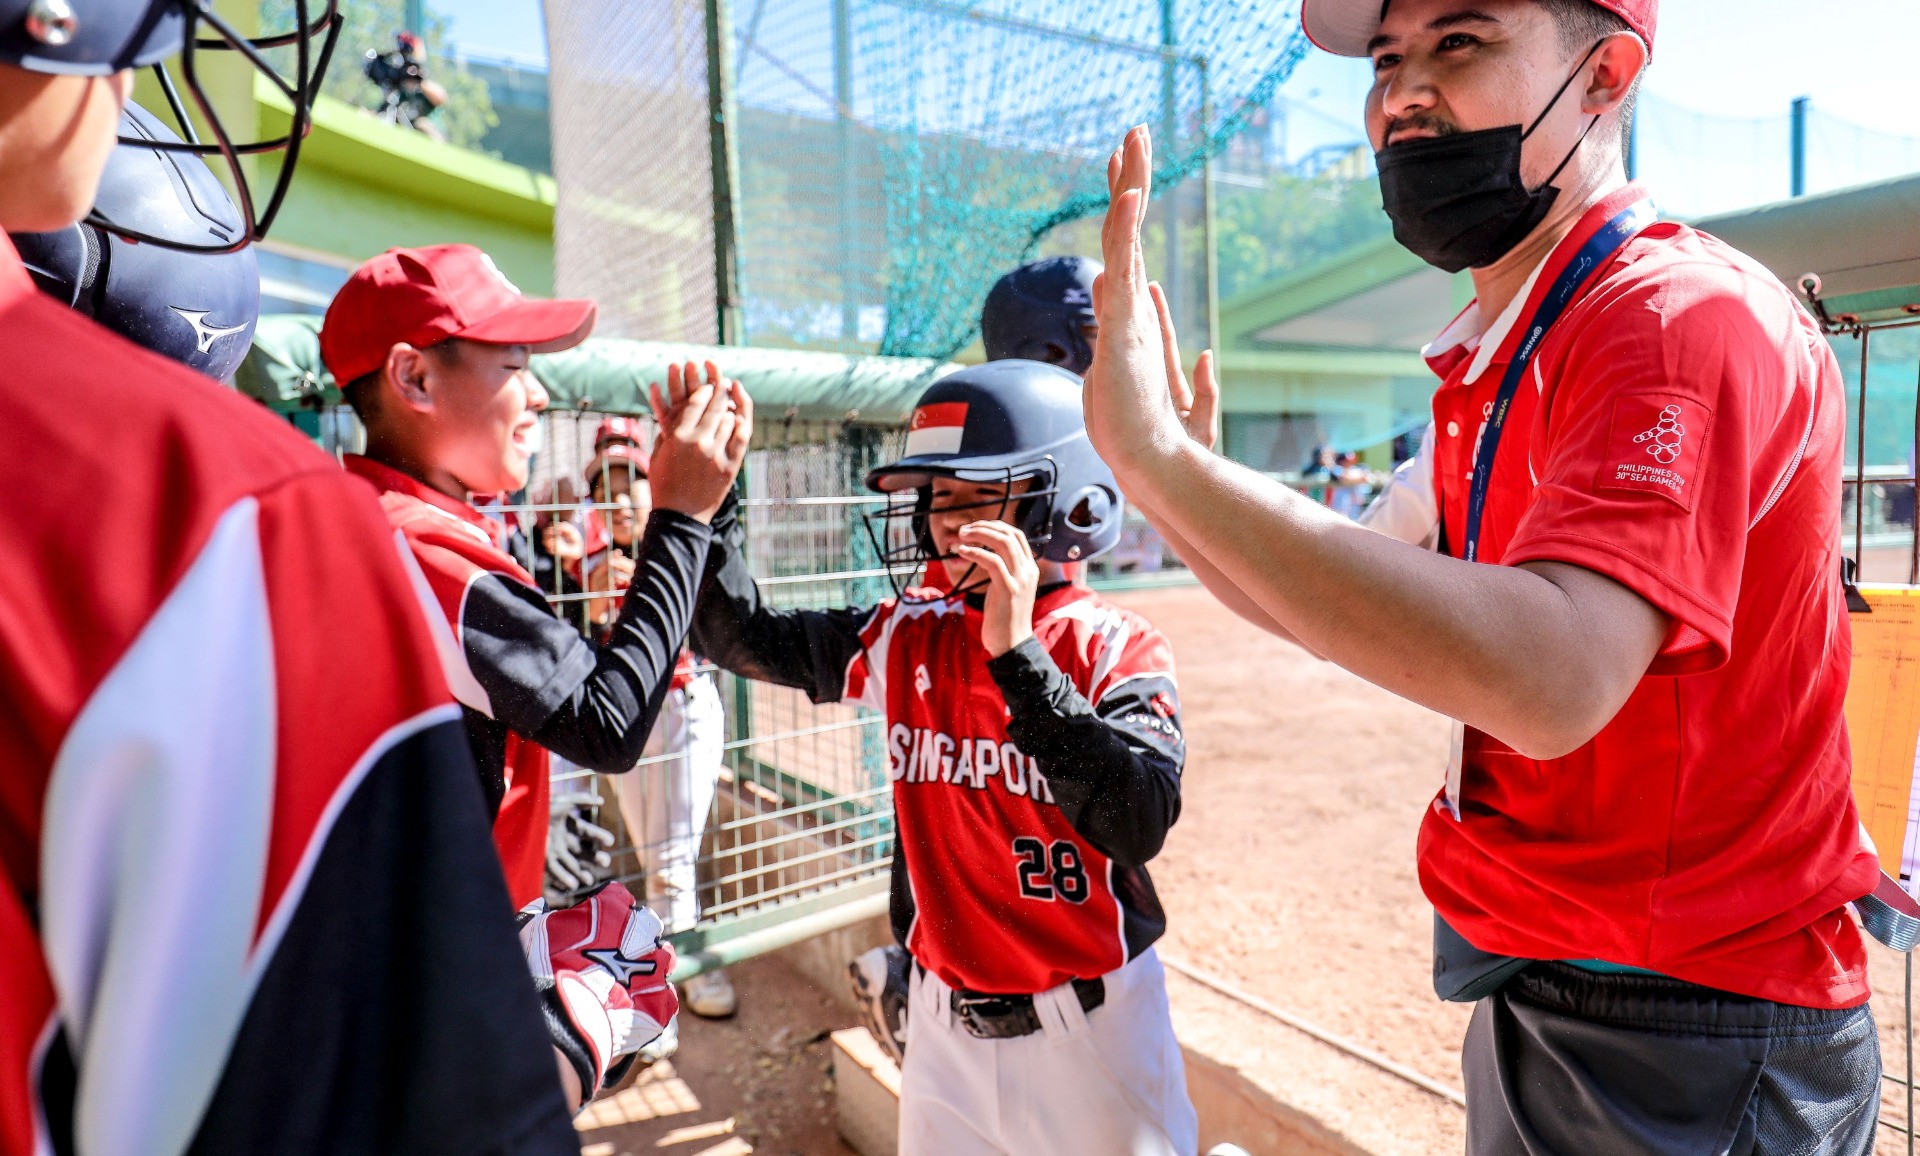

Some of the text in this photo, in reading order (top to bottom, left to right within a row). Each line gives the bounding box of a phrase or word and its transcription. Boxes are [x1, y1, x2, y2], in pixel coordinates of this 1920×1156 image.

[1617, 464, 1672, 477] PHILIPPINES
[1630, 472, 1647, 481] SEA
[1012, 836, 1090, 905] 28
